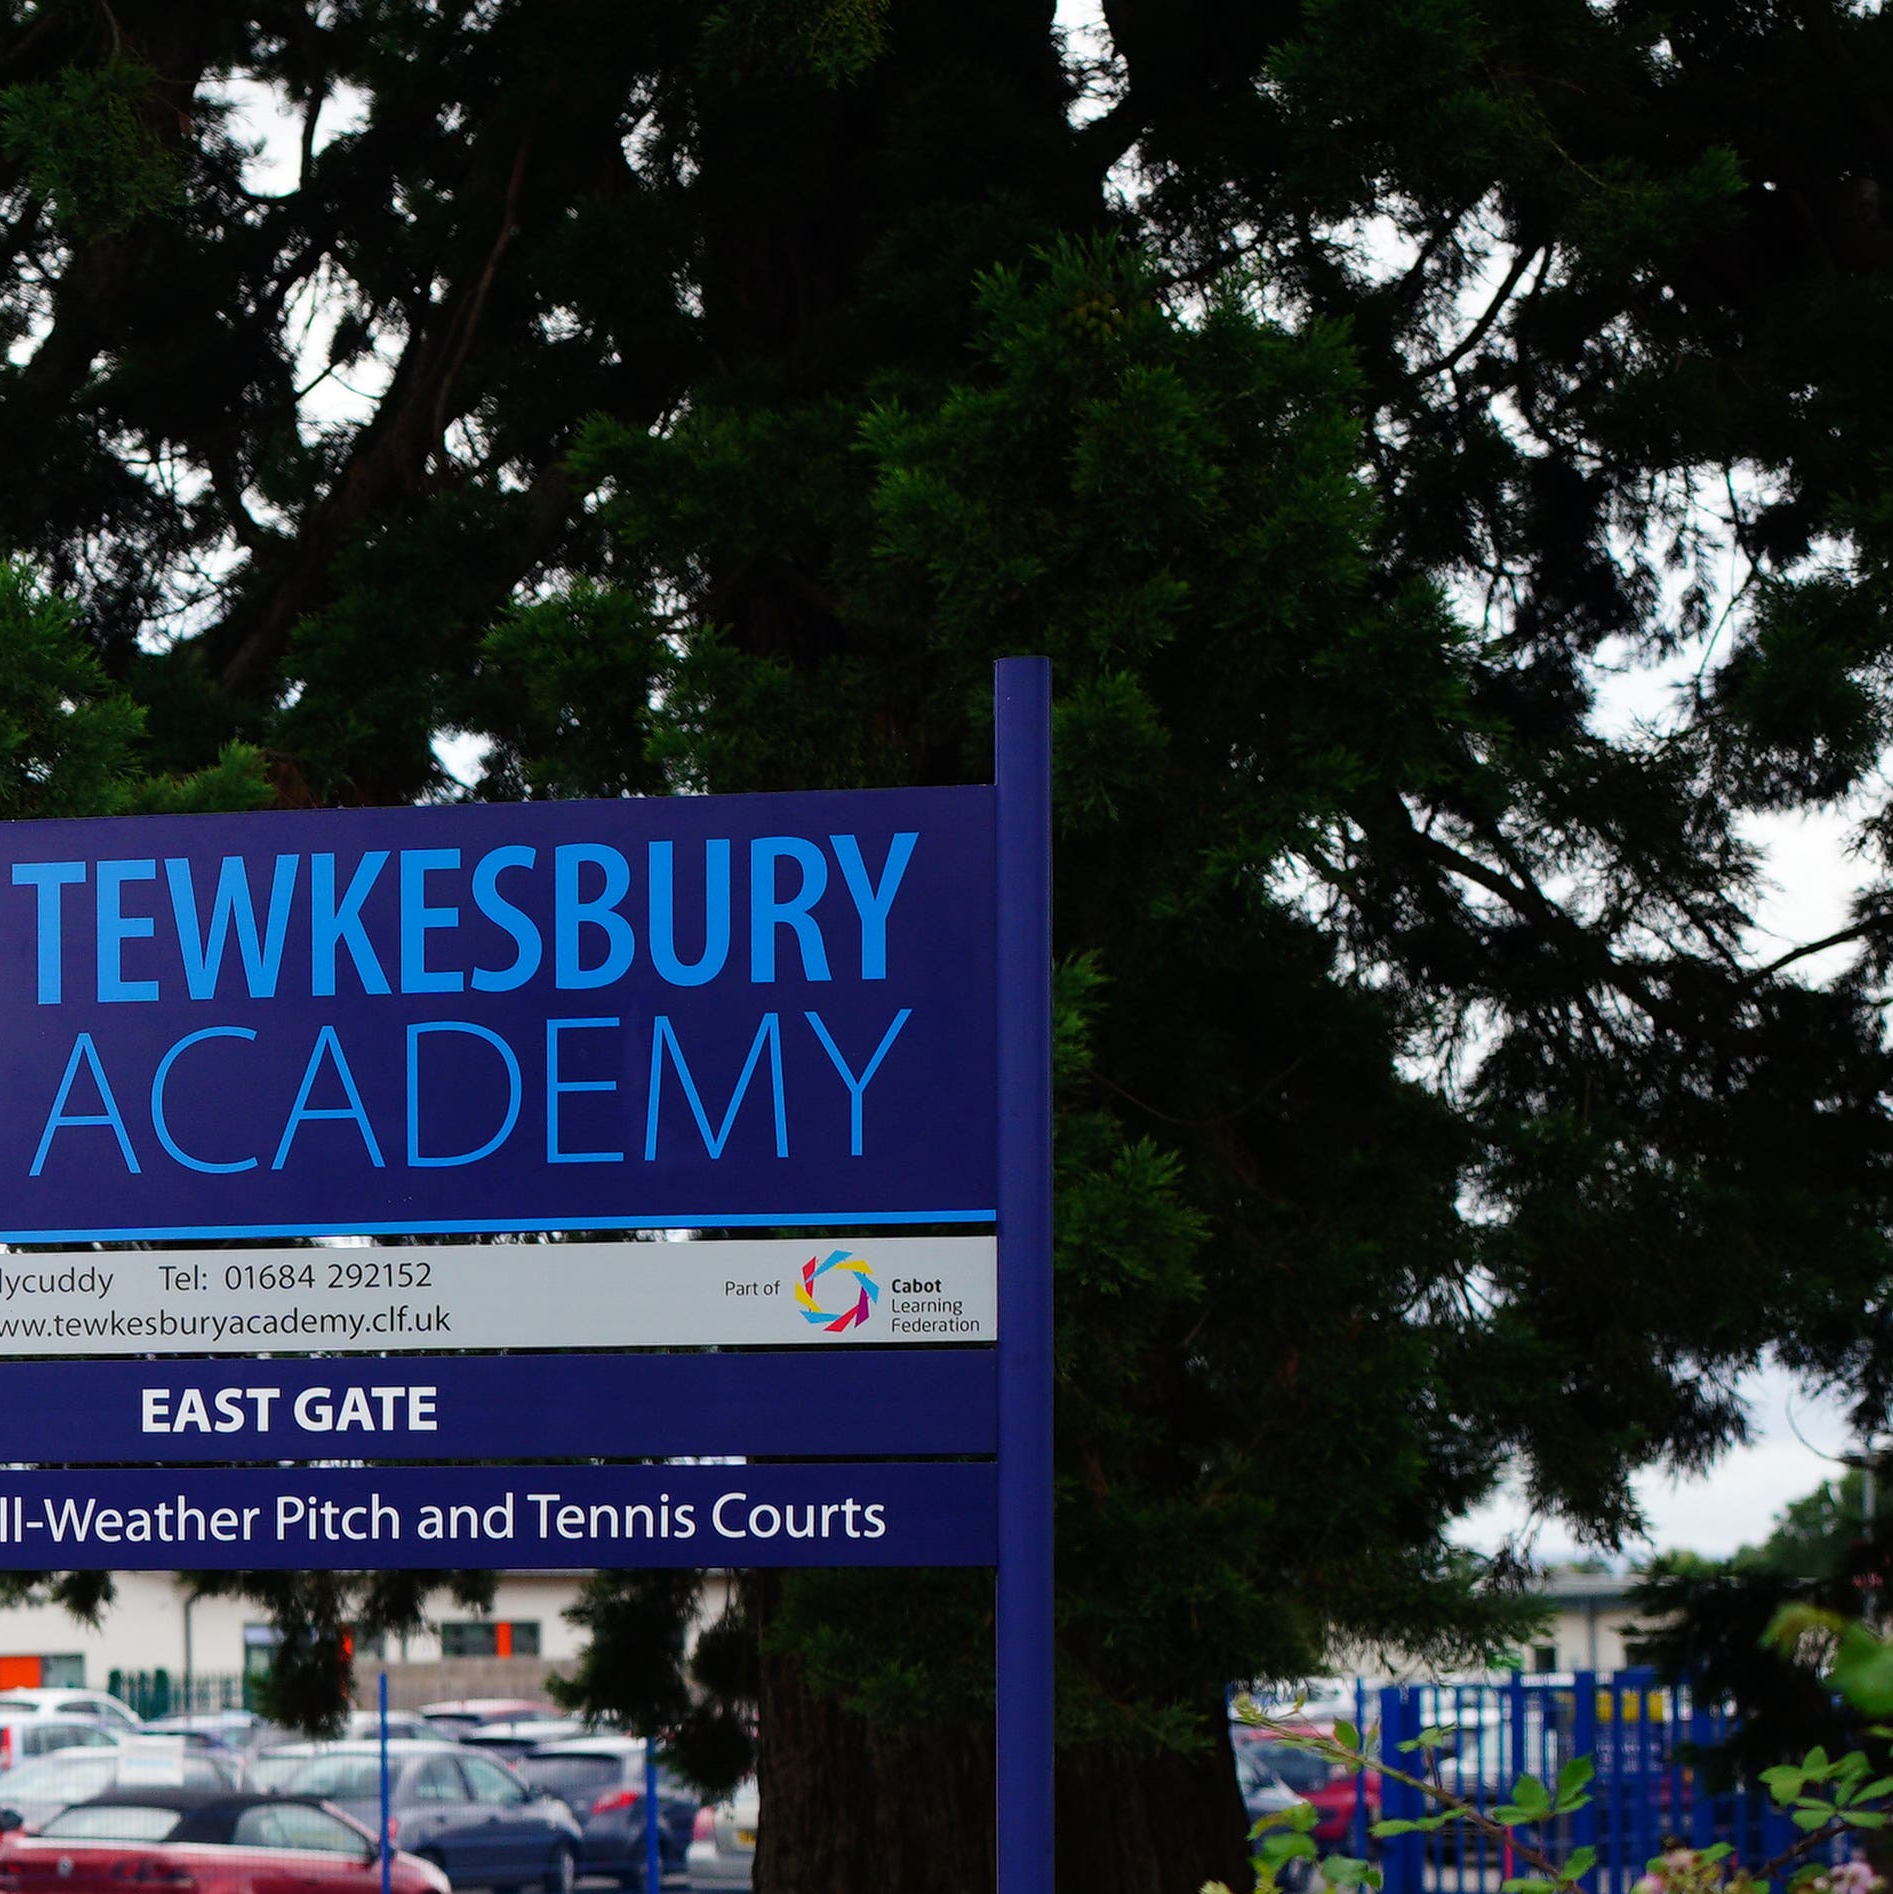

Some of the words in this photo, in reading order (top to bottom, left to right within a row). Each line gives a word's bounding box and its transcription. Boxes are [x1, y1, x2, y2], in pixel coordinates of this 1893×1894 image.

[12, 832, 919, 1005] TEWKESBURY
[29, 1009, 912, 1176] ACADEMY
[159, 1265, 206, 1290] Tel:
[226, 1265, 315, 1290] 01684
[328, 1263, 431, 1288] 292152
[726, 1281, 758, 1296] Part
[764, 1280, 780, 1295] of
[892, 1279, 941, 1293] Cabot
[892, 1298, 962, 1316] Learning
[892, 1317, 979, 1332] Federation
[143, 1388, 280, 1432] EAST
[294, 1387, 437, 1431] GATE
[277, 1494, 399, 1540] Pitch
[418, 1493, 513, 1539] and
[527, 1494, 695, 1538] Tennis
[713, 1493, 885, 1537] Courts
